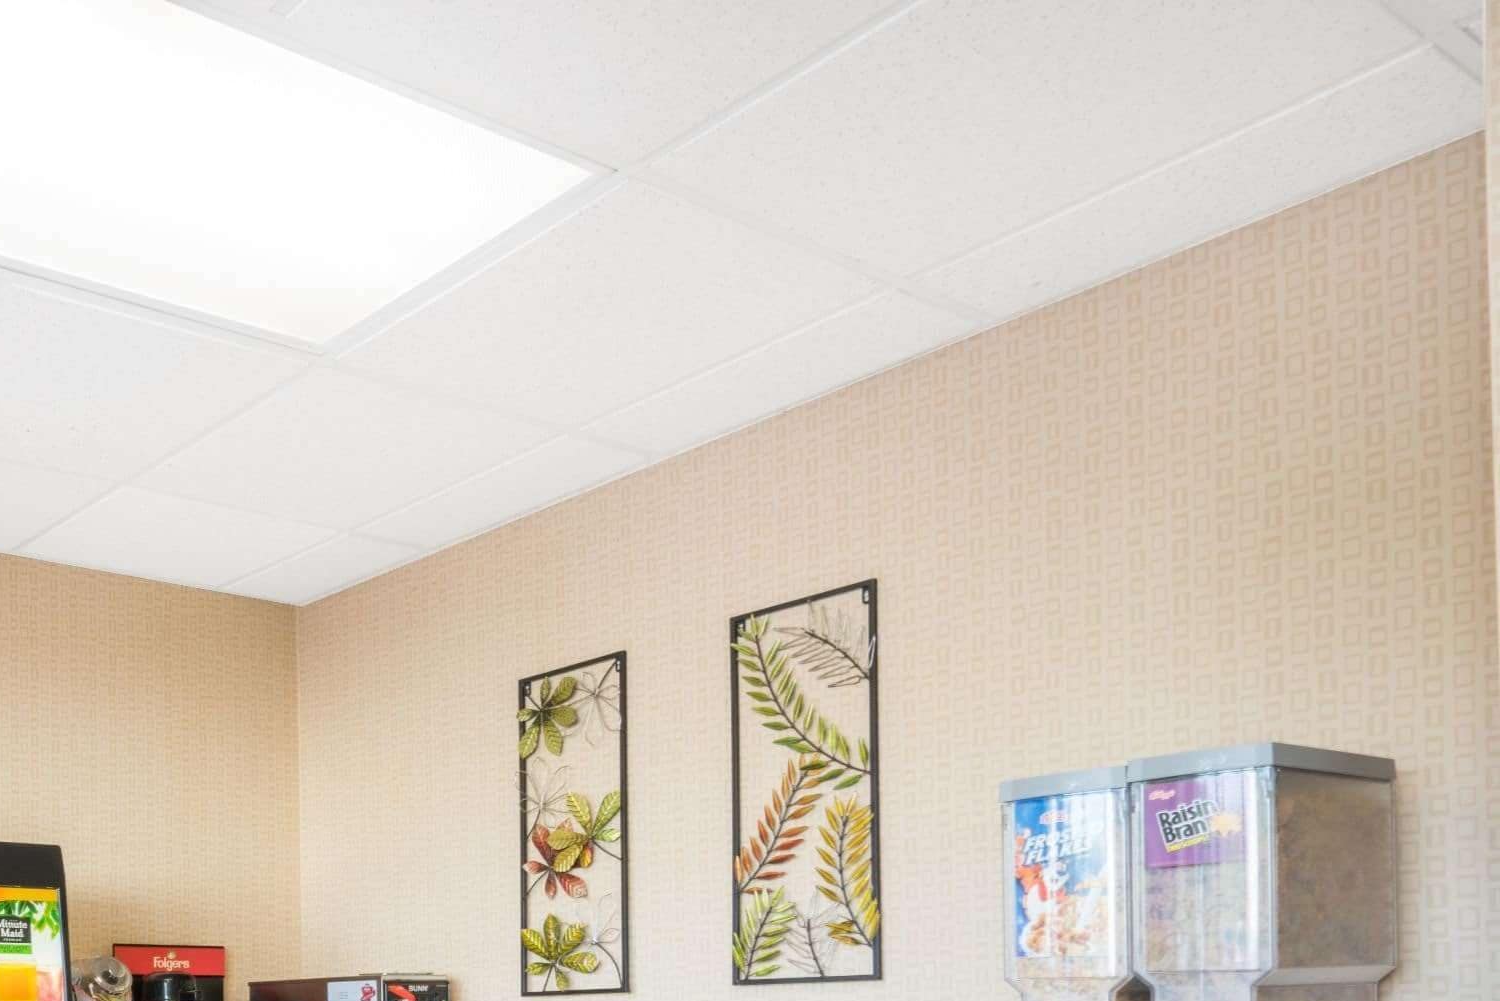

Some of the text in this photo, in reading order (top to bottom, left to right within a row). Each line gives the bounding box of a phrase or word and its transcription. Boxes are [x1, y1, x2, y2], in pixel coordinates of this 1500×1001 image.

[1158, 800, 1218, 828] Raisin
[1163, 819, 1207, 843] Bran
[0, 928, 24, 938] Maid
[153, 956, 190, 971] Folgers
